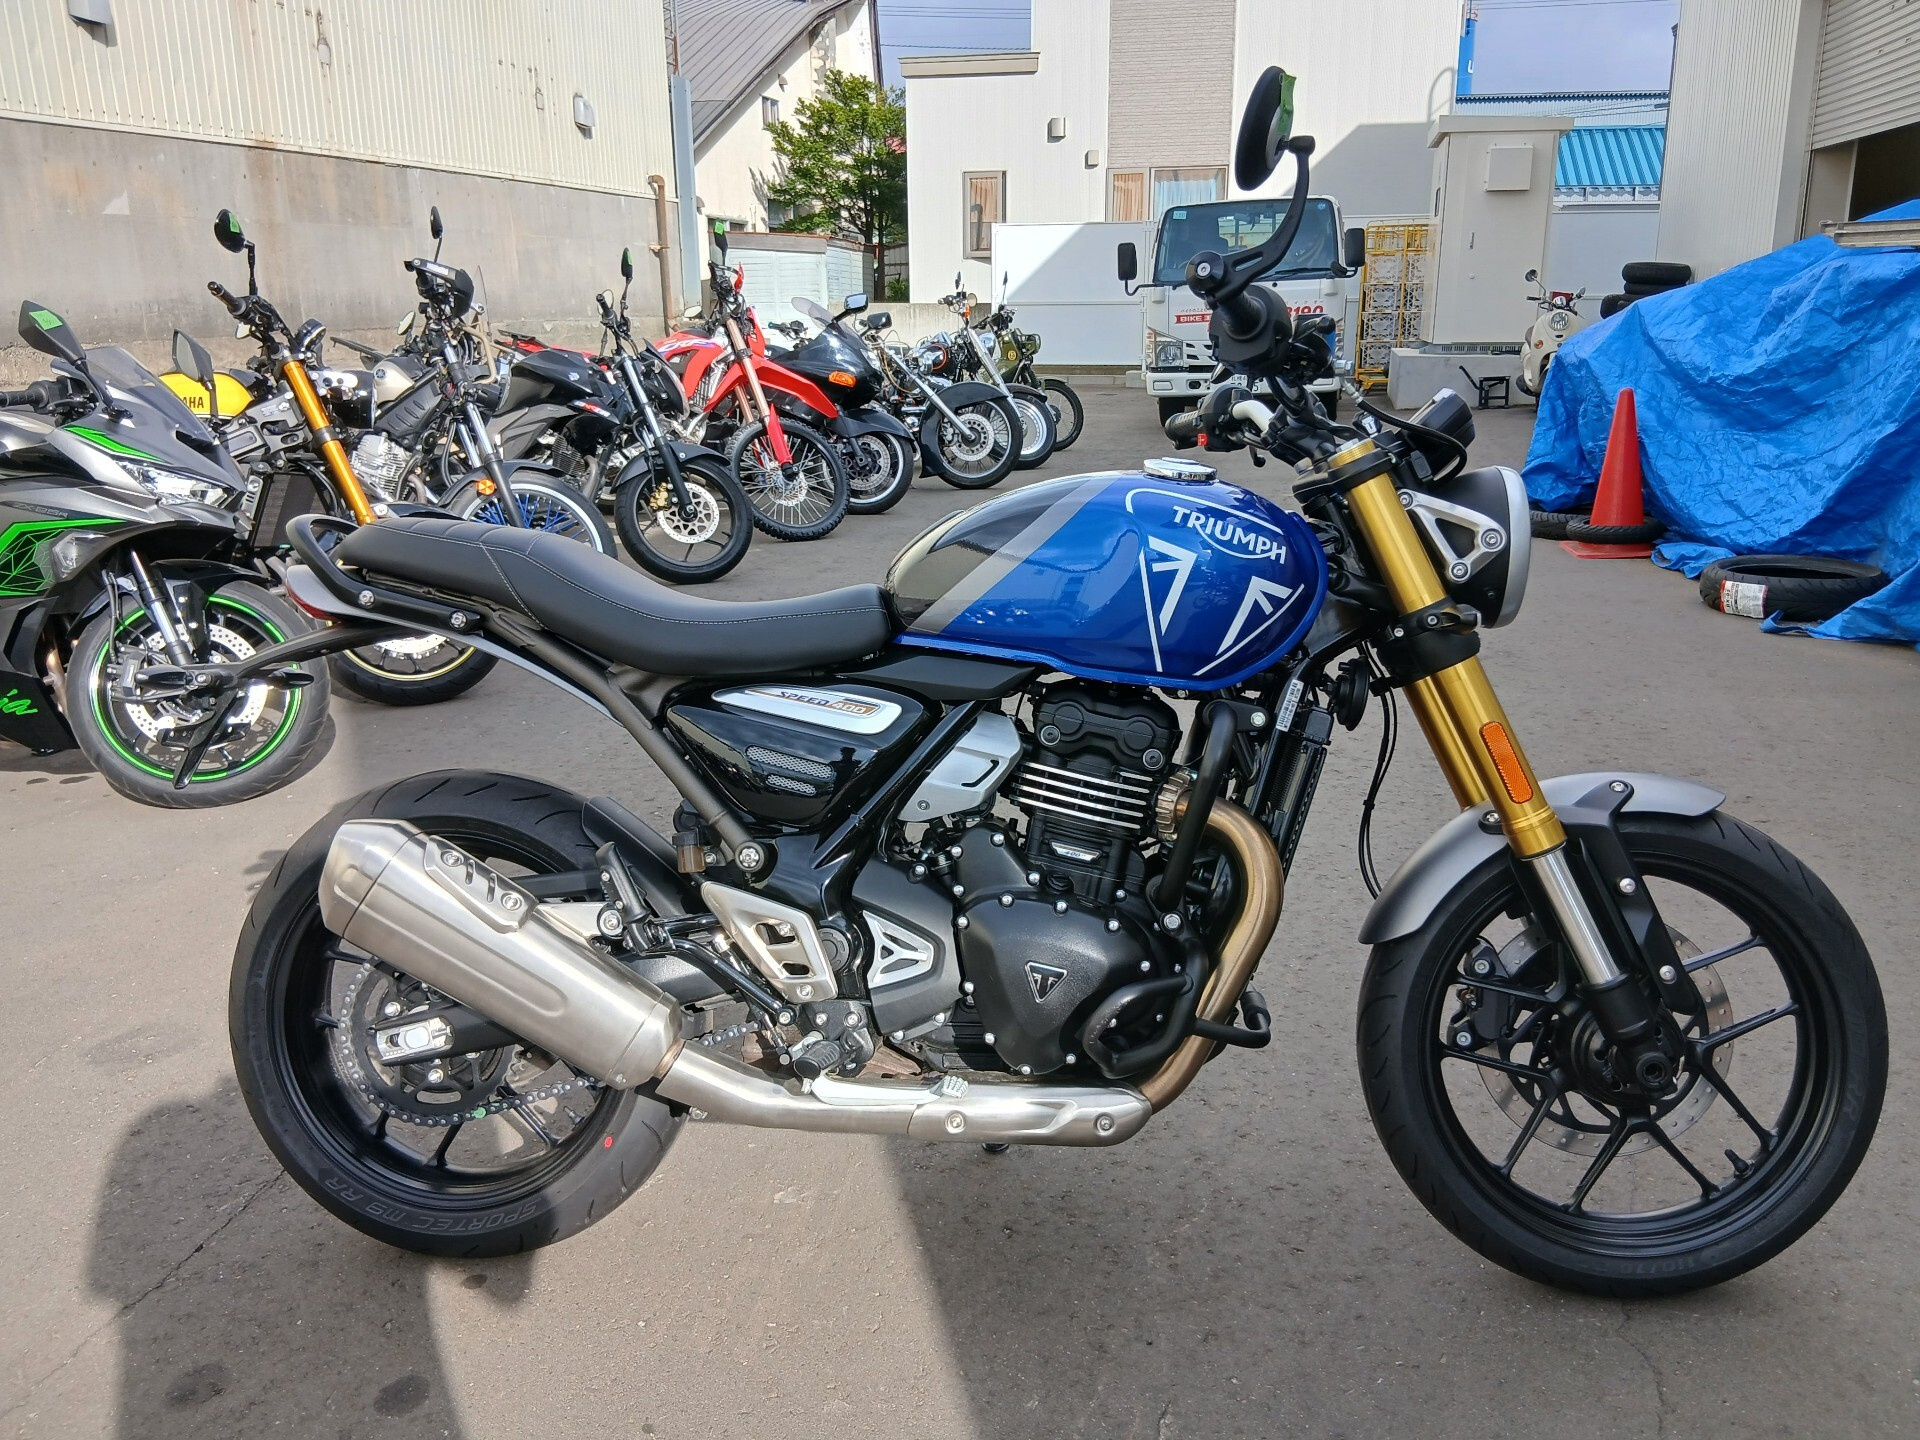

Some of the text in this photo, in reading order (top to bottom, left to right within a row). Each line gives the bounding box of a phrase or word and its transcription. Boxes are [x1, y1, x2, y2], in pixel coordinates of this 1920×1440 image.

[1180, 315, 1203, 323] BIKE
[1172, 505, 1287, 565] TRIUMPH
[779, 691, 867, 715] SPEED 400
[324, 1176, 361, 1202] RR
[411, 1197, 543, 1234] SPORTEC
